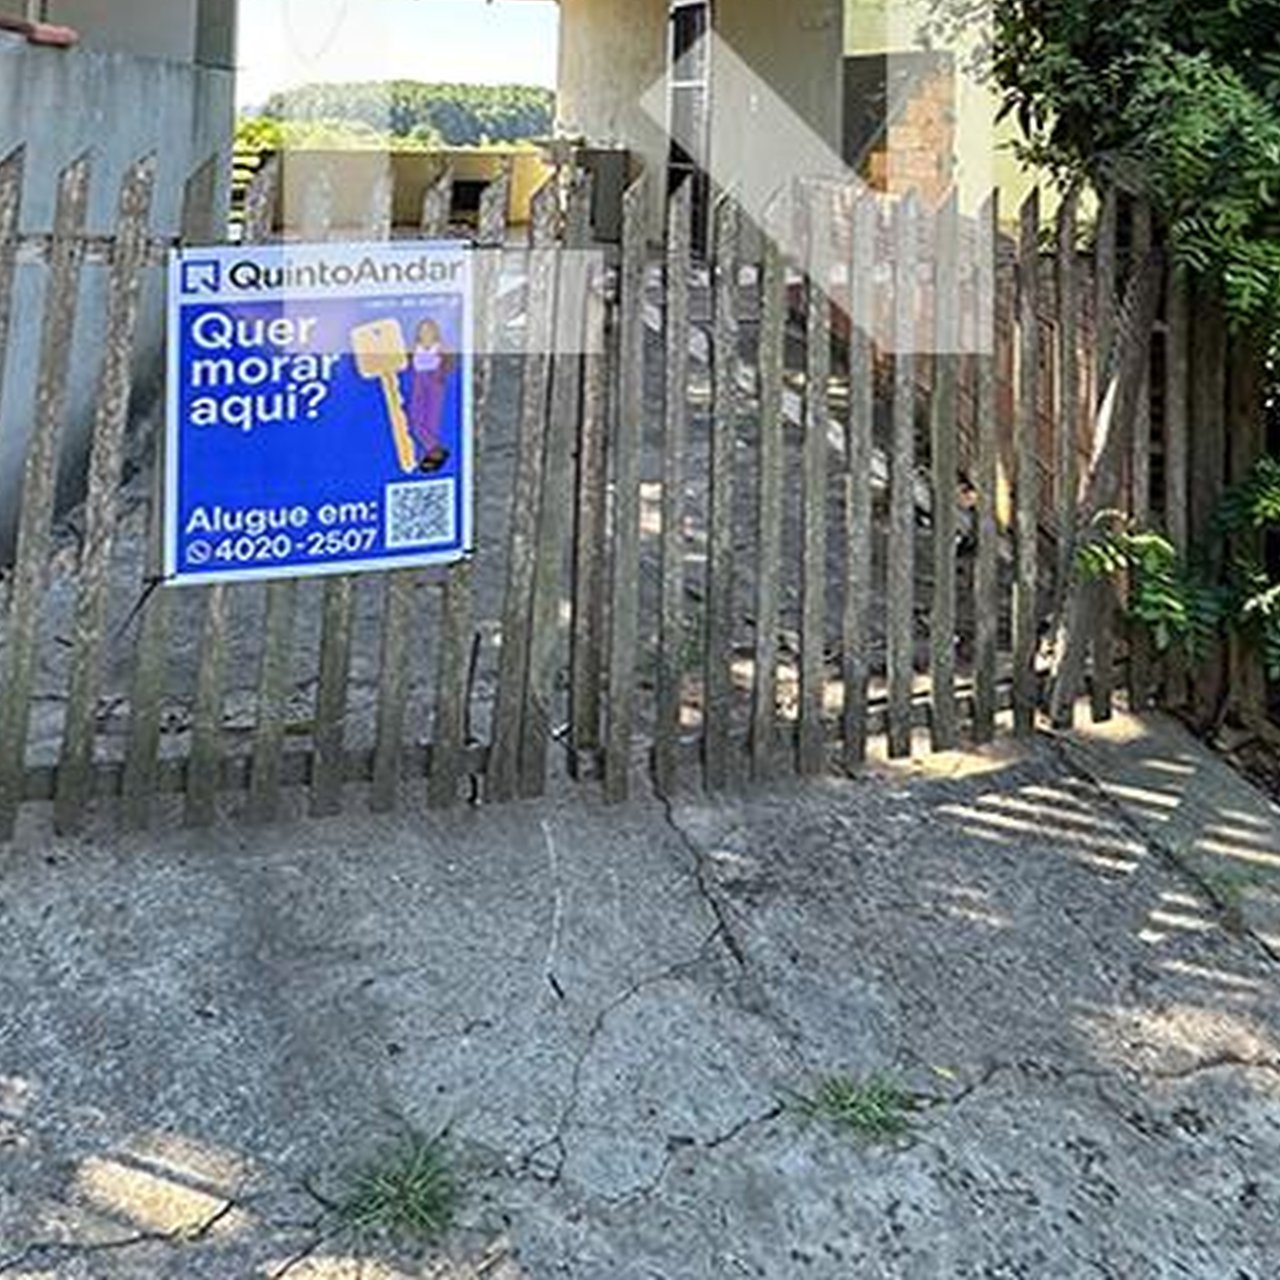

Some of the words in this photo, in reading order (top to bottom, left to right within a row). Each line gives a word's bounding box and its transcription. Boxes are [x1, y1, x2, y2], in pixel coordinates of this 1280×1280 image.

[229, 257, 463, 291] QuintoAndar
[192, 311, 318, 349] Quer
[191, 353, 340, 387] morar
[190, 382, 328, 431] aqui?
[185, 505, 309, 536] Alugue
[317, 501, 379, 527] em:
